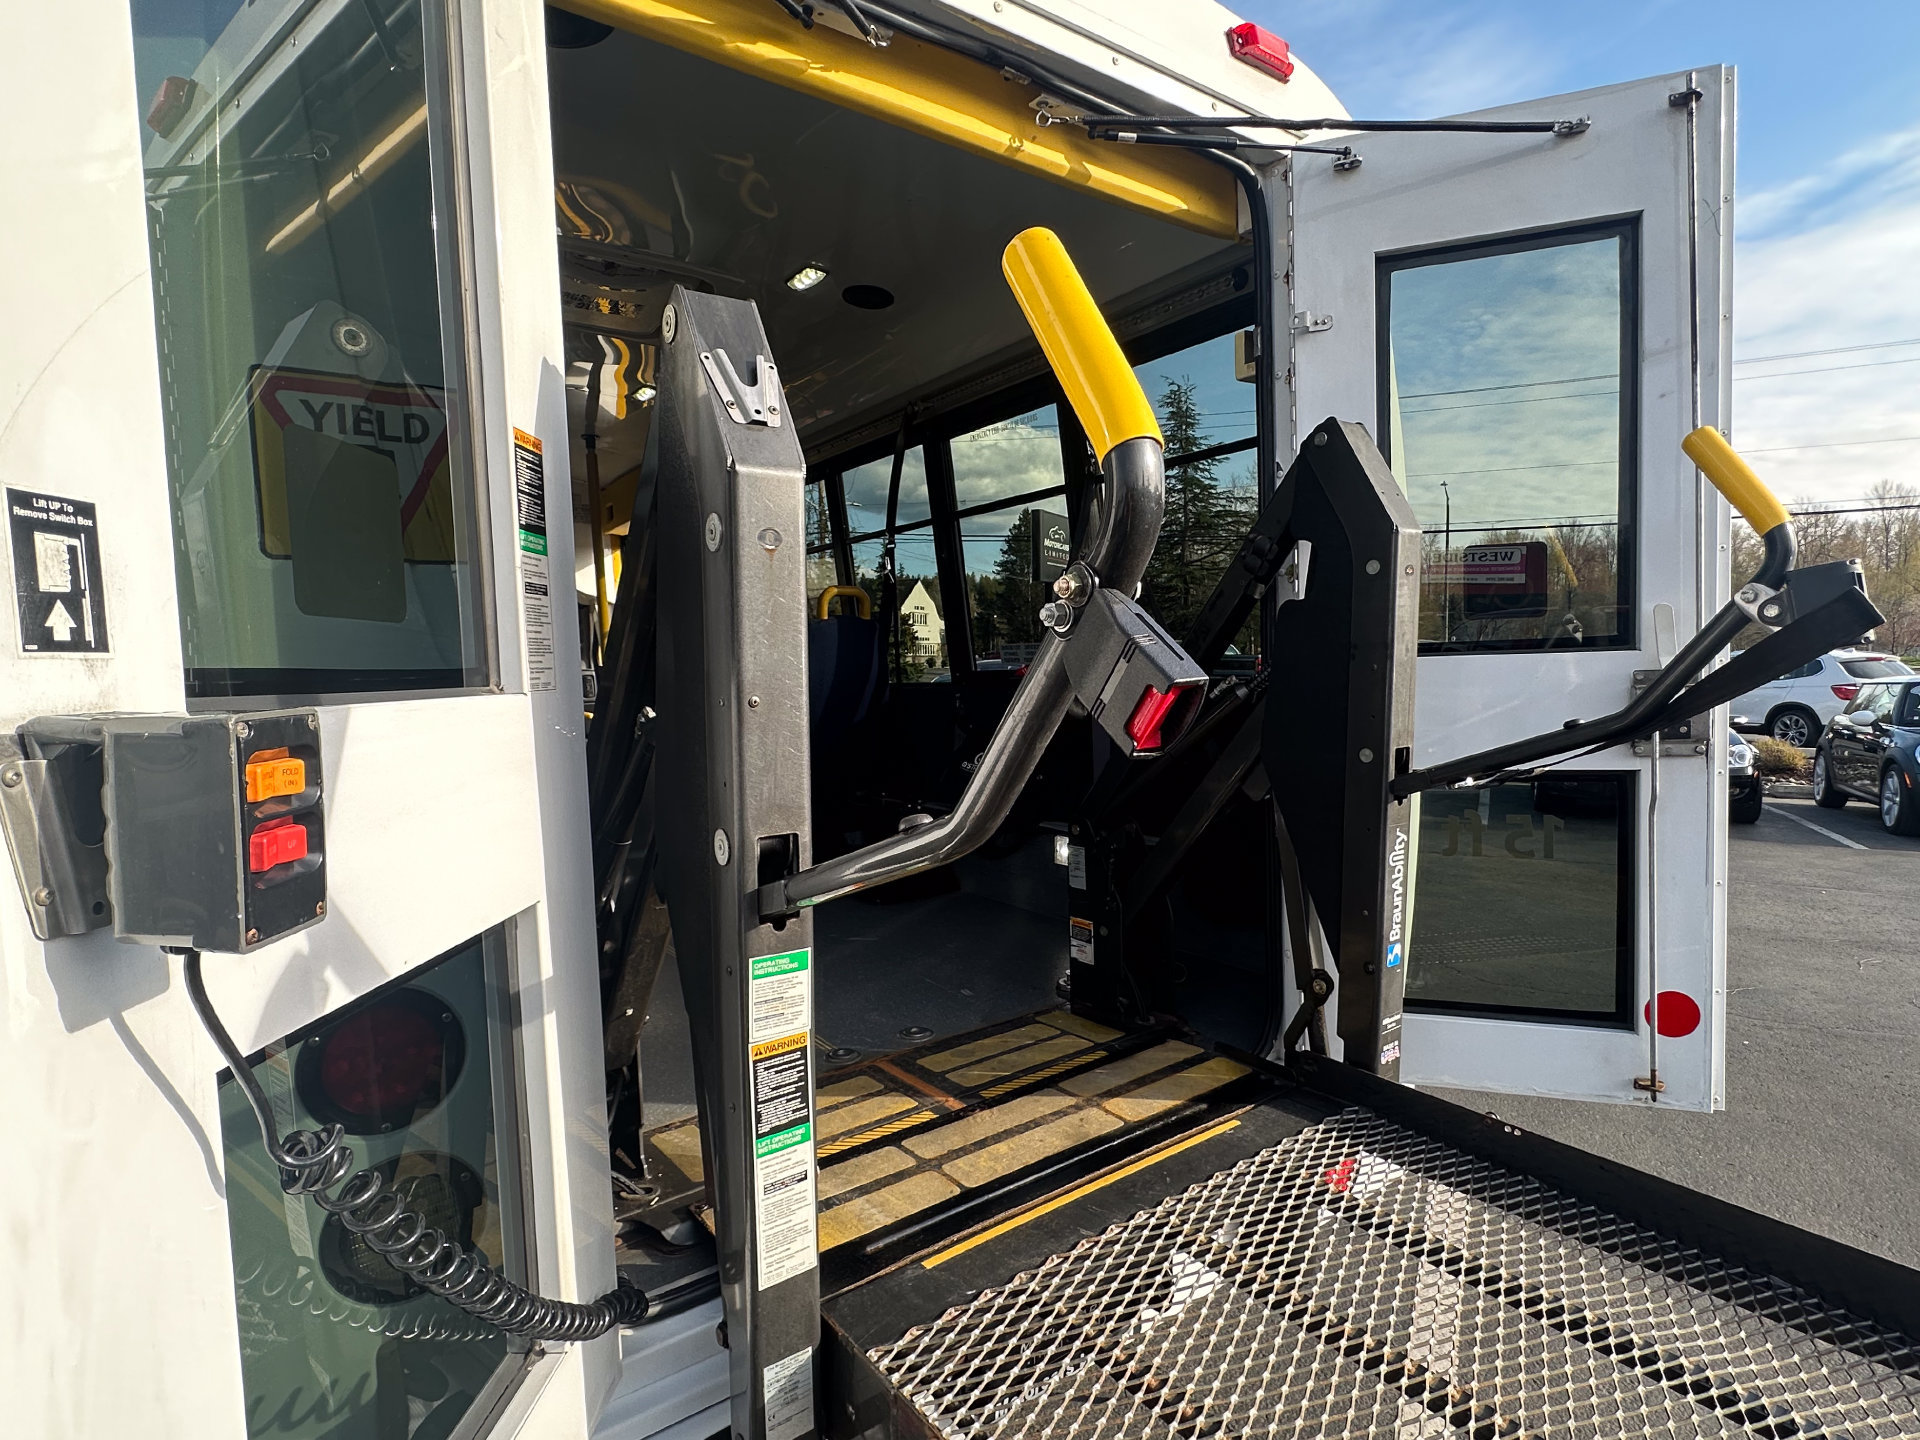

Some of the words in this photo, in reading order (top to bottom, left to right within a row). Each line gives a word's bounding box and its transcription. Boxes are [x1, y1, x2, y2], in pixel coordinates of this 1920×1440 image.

[299, 398, 430, 444] YIELD
[32, 497, 48, 508] Lift
[62, 503, 74, 513] To
[12, 505, 48, 520] Remove
[48, 511, 76, 524] Switch
[77, 516, 94, 527] Box
[1044, 549, 1070, 561] LIMITED
[282, 768, 299, 776] FOLD
[1389, 828, 1408, 942] BraunAbility
[753, 957, 790, 969] OPERATING
[753, 961, 799, 975] INSTRUCTIONS
[763, 1035, 806, 1054] WARNING
[771, 1127, 806, 1144] OPERATING
[757, 1134, 802, 1155] INSTRUCTIONS
